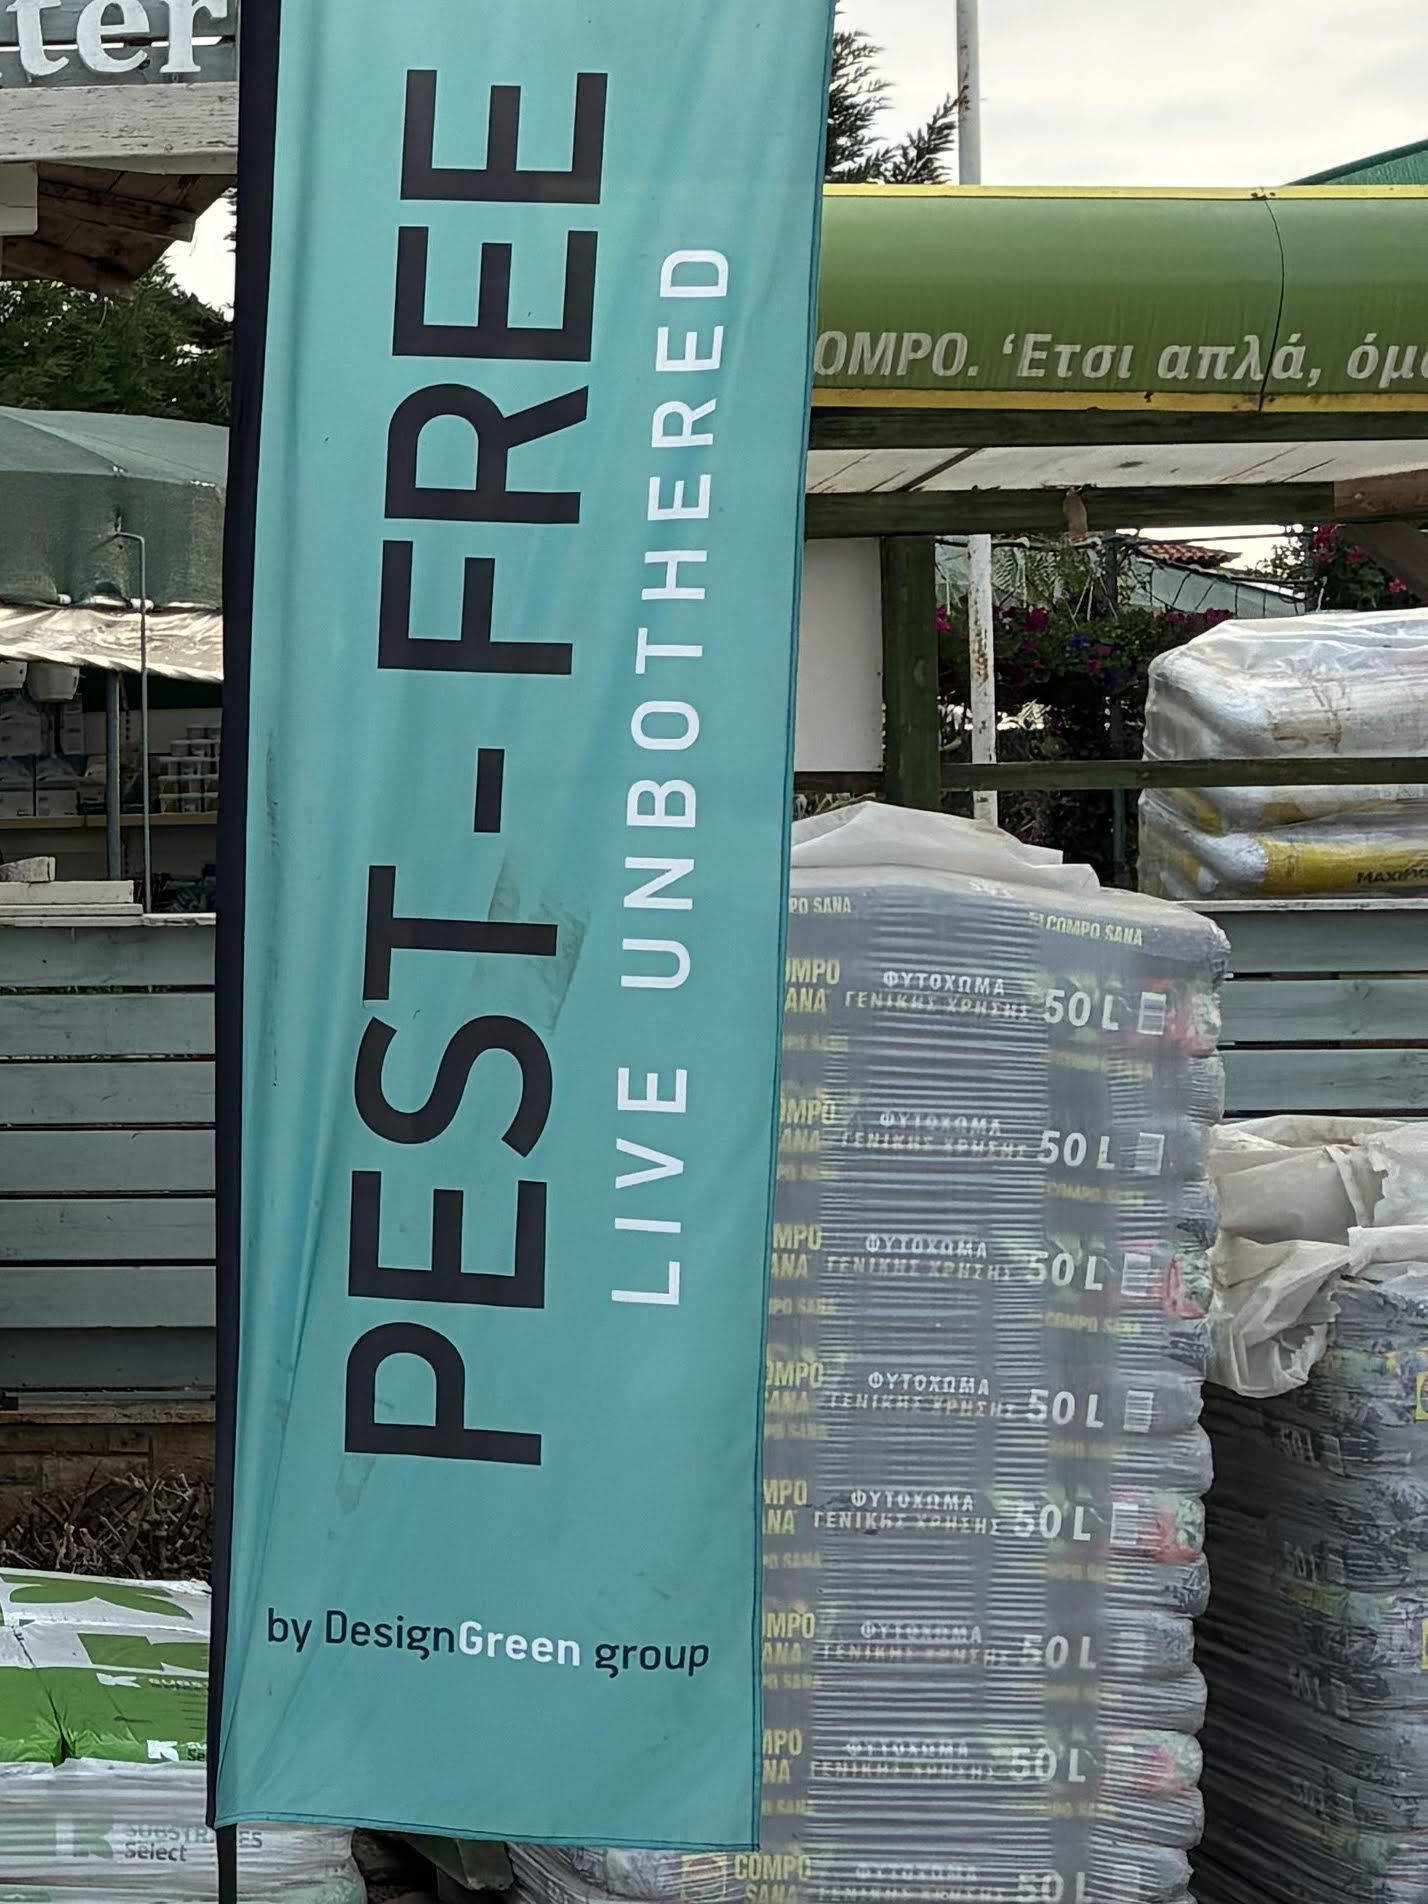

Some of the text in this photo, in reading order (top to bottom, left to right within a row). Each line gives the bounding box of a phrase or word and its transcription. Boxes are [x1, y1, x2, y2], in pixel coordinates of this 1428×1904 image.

[612, 250, 728, 1304] LIVE UNBOTHERED
[1045, 915, 1144, 947] COMPO SANA
[882, 970, 1006, 996] ΦΥΤΟΧΩΜΑ
[1044, 989, 1093, 1030] 50
[1039, 1131, 1089, 1169] 50
[865, 1233, 988, 1259] ΦΥΤΟΧΩΜΑ
[868, 1371, 991, 1397] ΦΥΤΟΧΩΜΑ
[1027, 1389, 1076, 1426] 50
[850, 1489, 975, 1513] ΦΥΤΟΧΩΜΑ
[267, 1607, 710, 1679] by DesignGreen group
[123, 1842, 188, 1862] Select
[734, 1853, 813, 1883] COMPO
